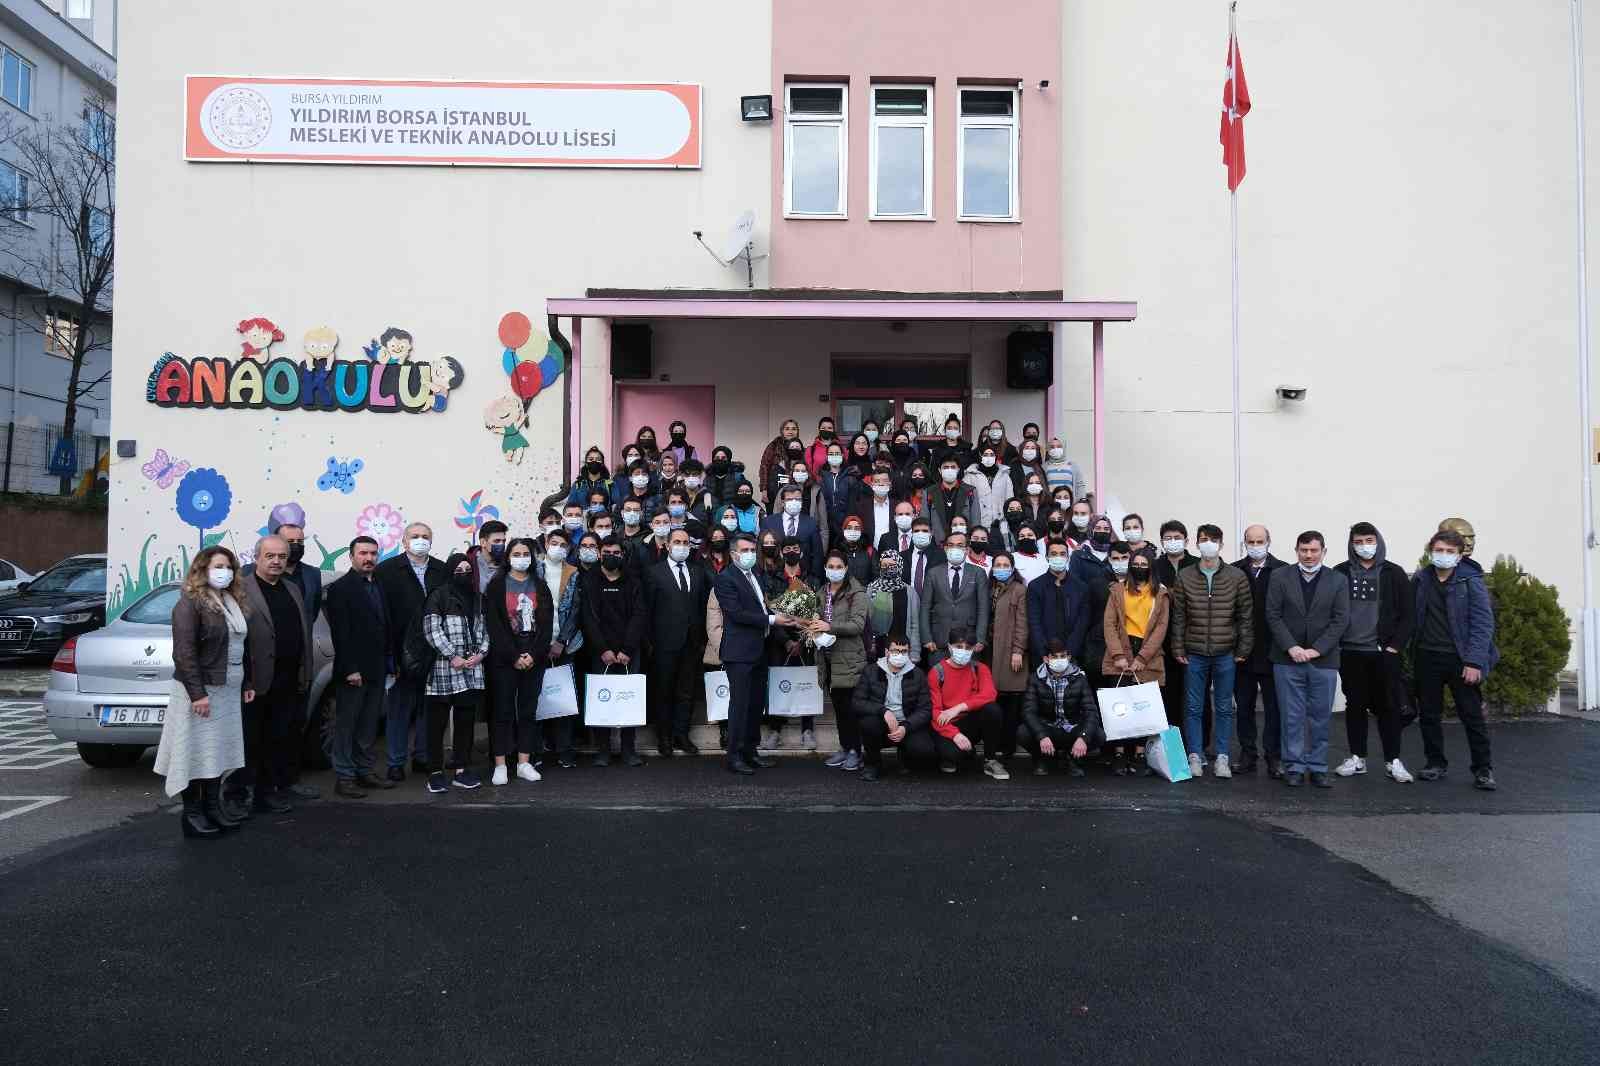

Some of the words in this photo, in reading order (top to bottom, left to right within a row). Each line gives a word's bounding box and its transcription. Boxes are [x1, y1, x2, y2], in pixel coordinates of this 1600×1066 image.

[291, 93, 330, 104] BURSA
[332, 94, 382, 105] YILDIRIM
[290, 108, 372, 124] YILDIRIM
[376, 109, 438, 125] BORSA
[443, 107, 532, 126] İSTANBUL
[289, 126, 367, 143] MESLEKİ
[370, 128, 394, 143] VE
[397, 126, 463, 145] TEKNİK
[468, 130, 558, 146] ANADOLU
[563, 128, 616, 147] LİSESİ
[155, 358, 434, 406] ANAOKULU
[114, 708, 127, 722] 16
[134, 709, 150, 722] KD
